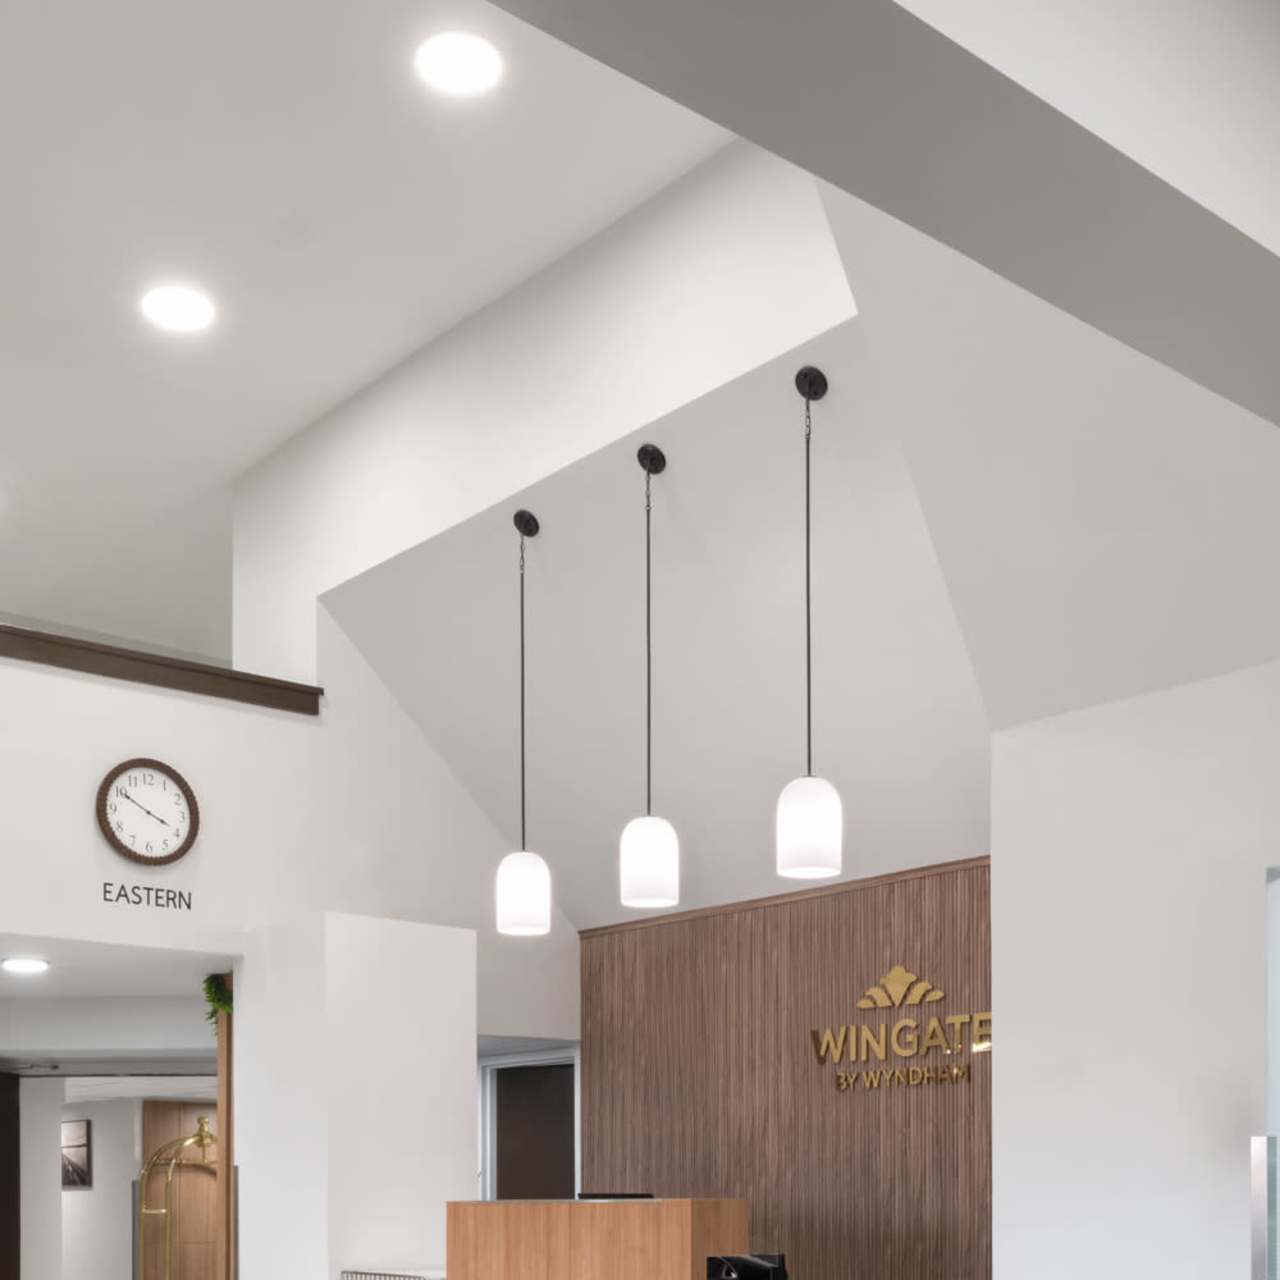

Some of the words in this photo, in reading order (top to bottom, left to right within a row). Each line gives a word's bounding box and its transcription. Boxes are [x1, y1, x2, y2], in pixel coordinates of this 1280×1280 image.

[128, 775, 138, 788] 11
[143, 773, 154, 786] 12
[115, 786, 127, 798] 10
[174, 793, 182, 806] 2
[110, 803, 117, 814] 9
[116, 821, 124, 832] 8
[129, 835, 136, 846] 7
[162, 839, 169, 850] 5
[145, 842, 153, 853] 6
[103, 882, 192, 911] EASTERN
[811, 1012, 992, 1064] WINGATE
[837, 1072, 858, 1090] BY
[863, 1064, 970, 1089] WYNDHAM
